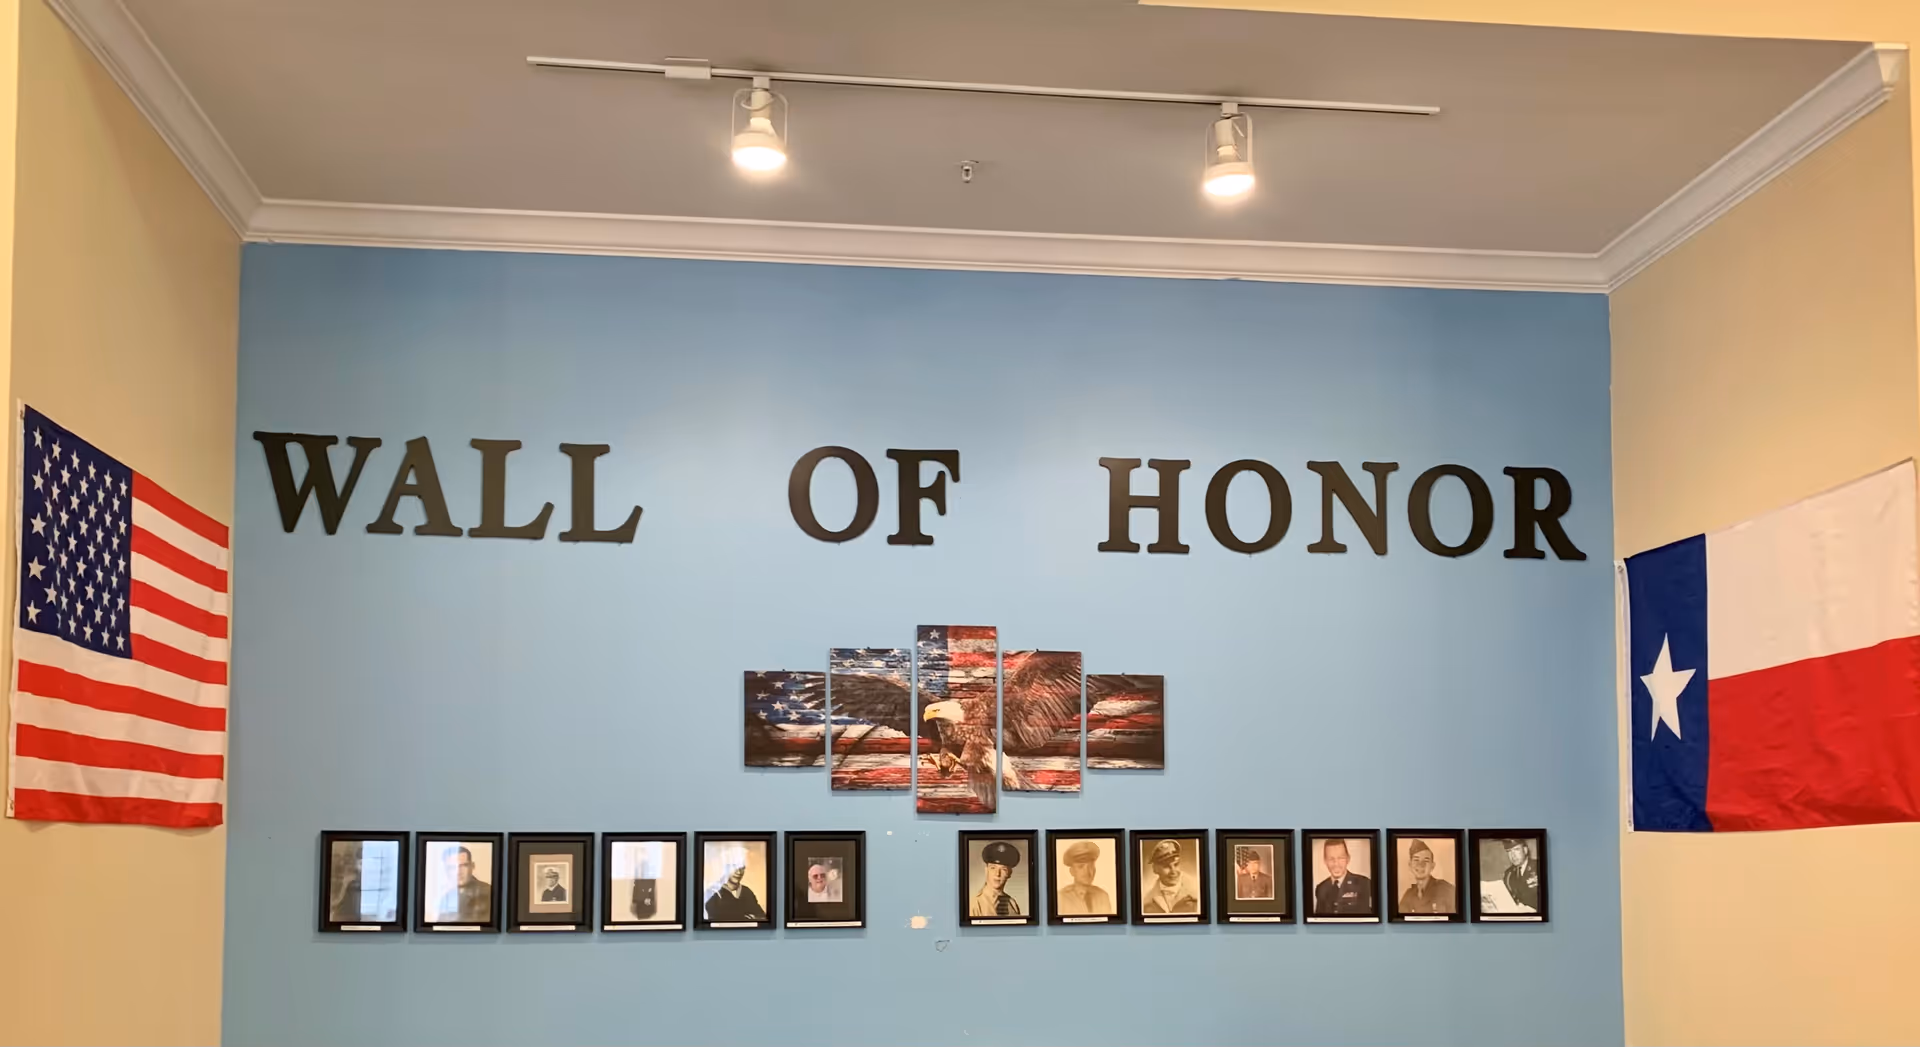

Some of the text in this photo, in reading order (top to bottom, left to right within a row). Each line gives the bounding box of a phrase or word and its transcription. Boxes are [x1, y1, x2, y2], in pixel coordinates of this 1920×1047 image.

[253, 431, 1588, 562] WALL OF HONOR
